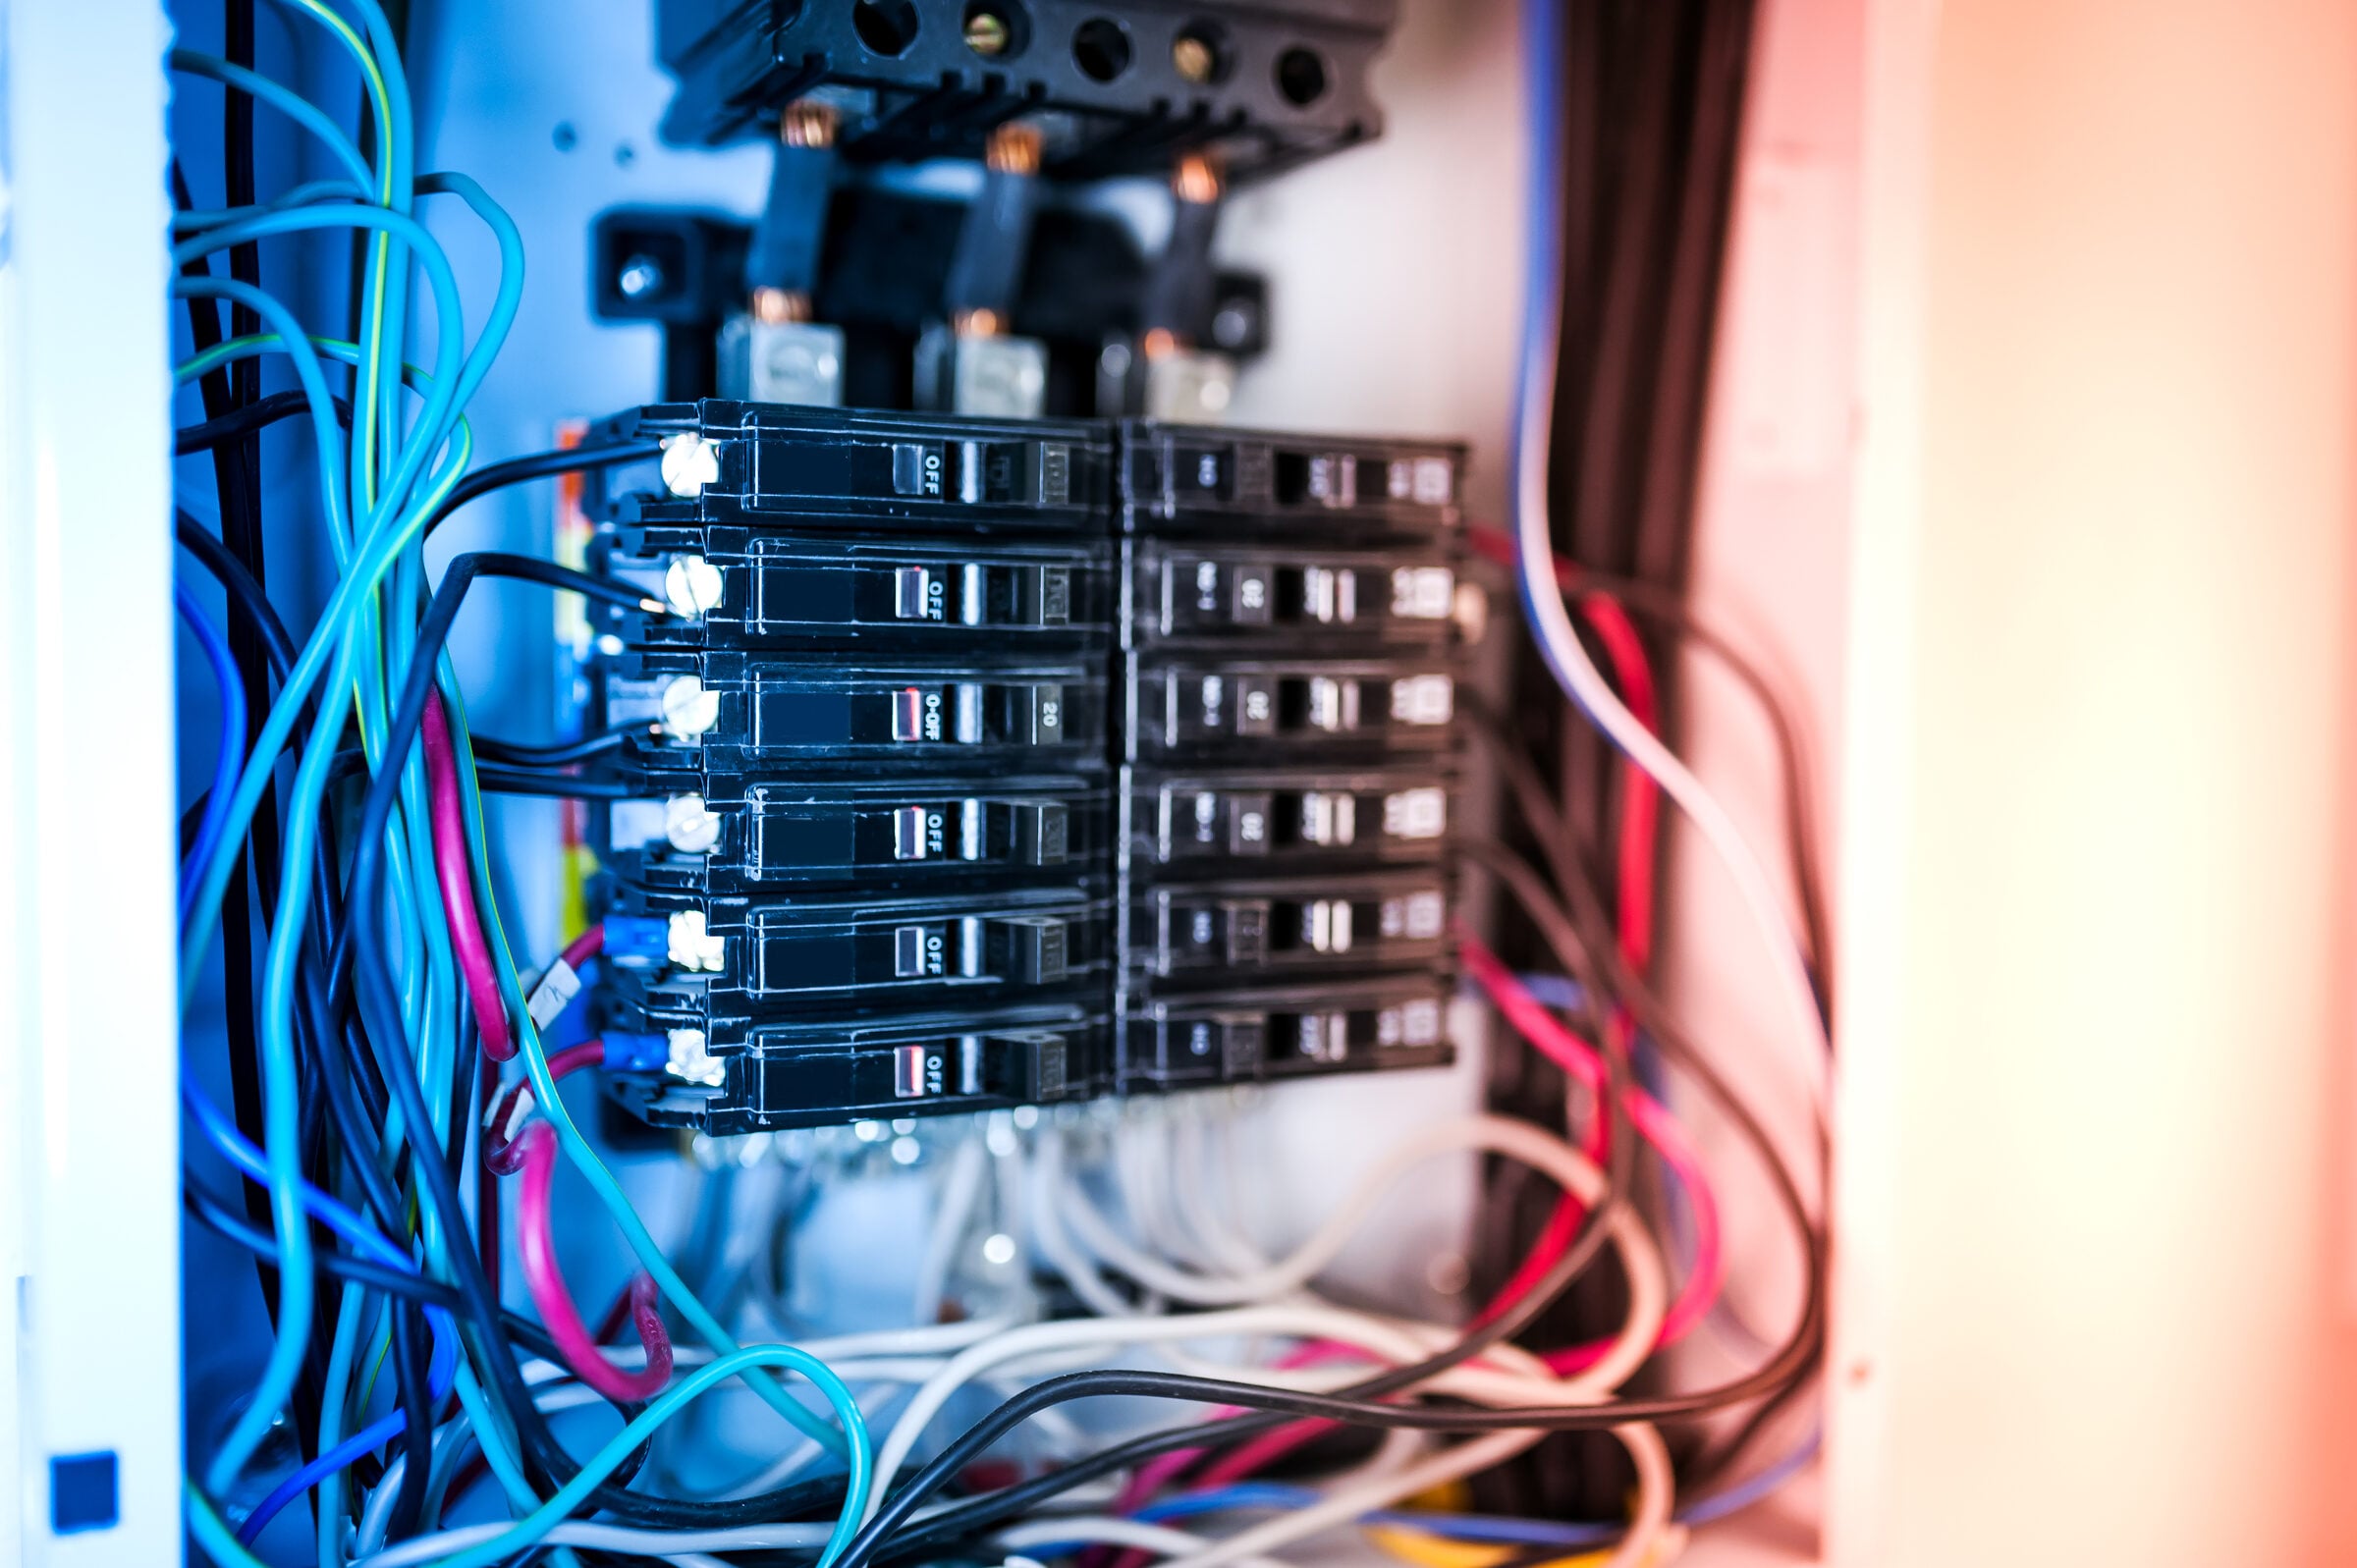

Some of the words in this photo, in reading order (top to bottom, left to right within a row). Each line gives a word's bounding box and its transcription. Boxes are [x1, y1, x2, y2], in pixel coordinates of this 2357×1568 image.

[925, 455, 941, 495] OFF
[928, 580, 944, 621] OFF
[1043, 701, 1059, 728] 20
[927, 813, 943, 853] OFF
[927, 936, 943, 974] OFF
[927, 1055, 943, 1094] OFF
